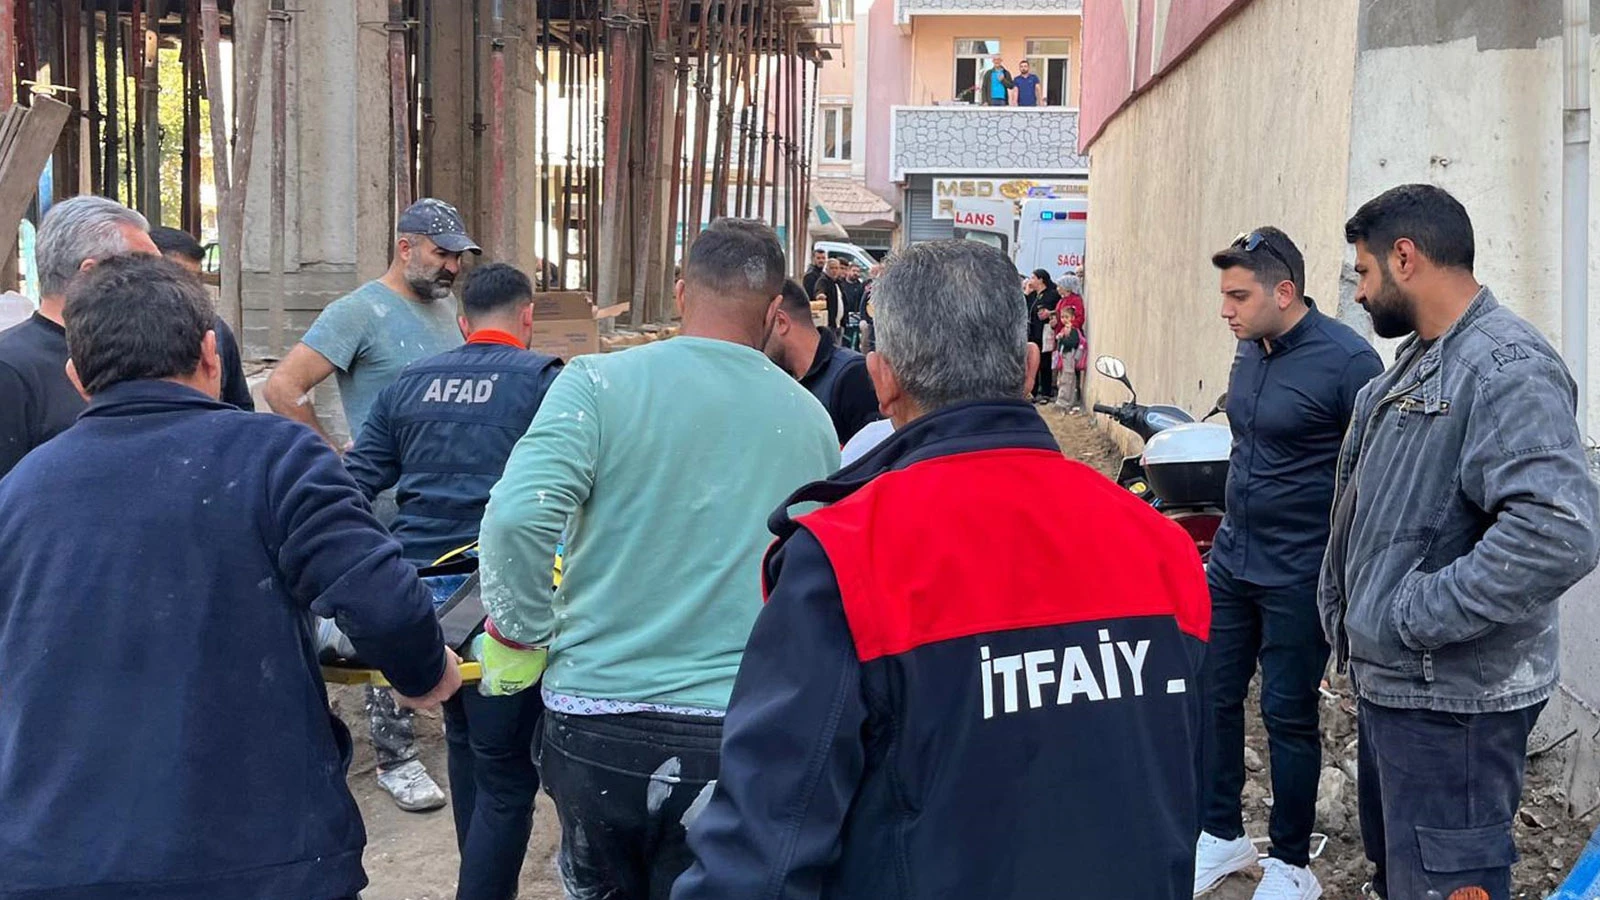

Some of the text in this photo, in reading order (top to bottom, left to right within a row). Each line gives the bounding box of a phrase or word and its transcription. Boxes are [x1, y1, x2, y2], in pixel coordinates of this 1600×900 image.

[937, 181, 993, 197] MSD
[956, 212, 995, 226] LANS
[422, 379, 493, 404] AFAD
[980, 629, 1186, 719] İTFAİY
